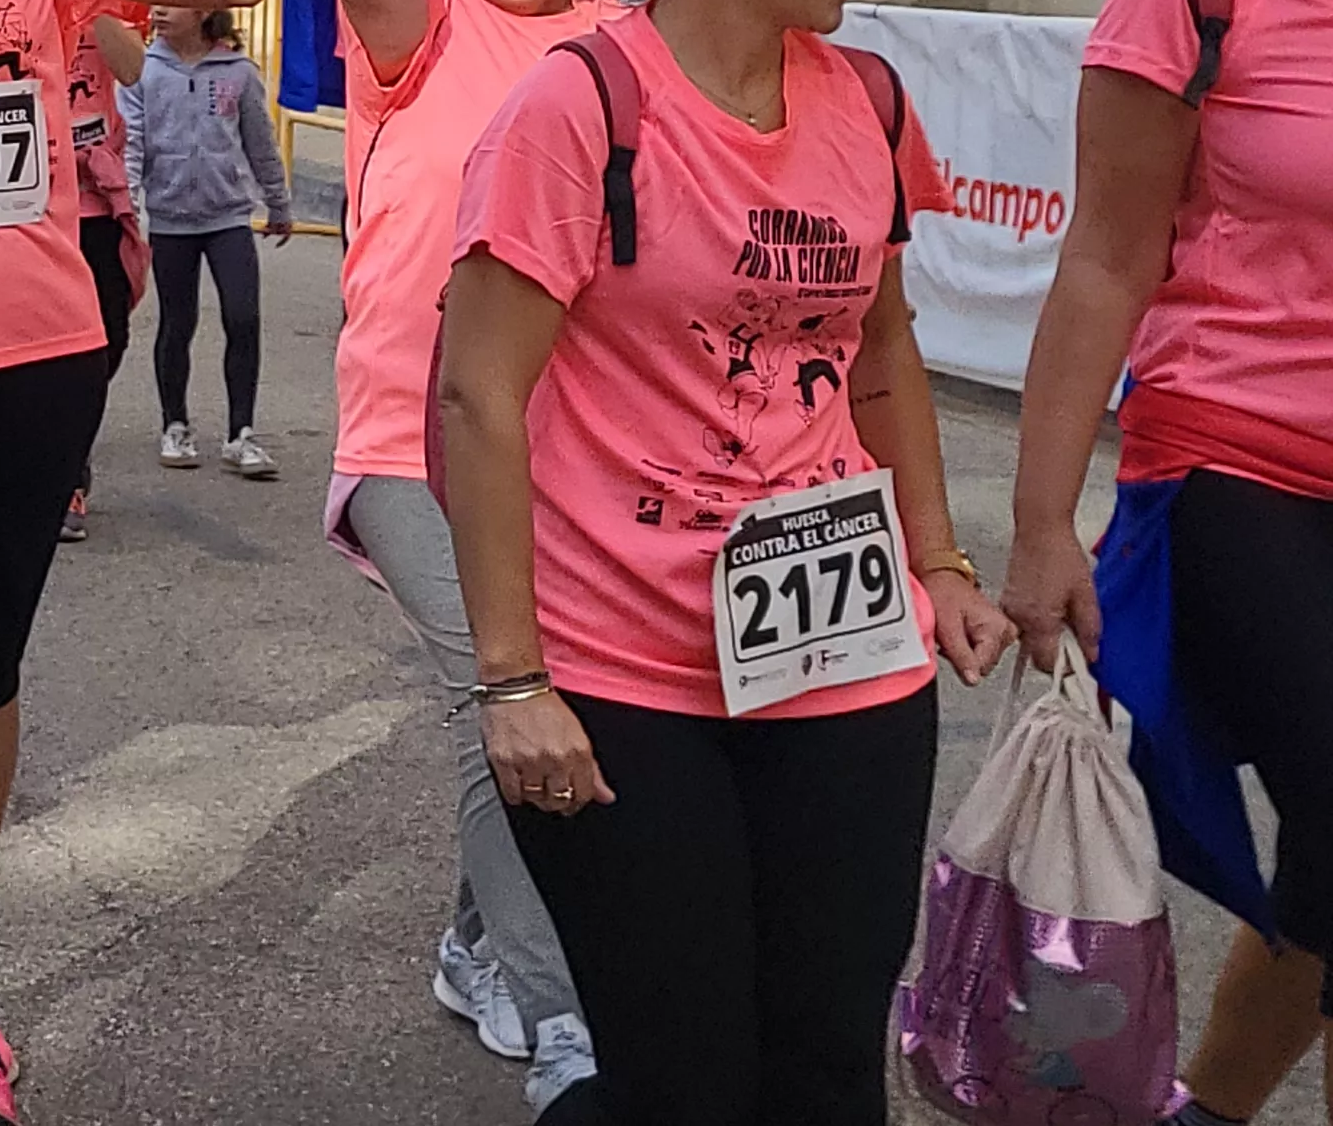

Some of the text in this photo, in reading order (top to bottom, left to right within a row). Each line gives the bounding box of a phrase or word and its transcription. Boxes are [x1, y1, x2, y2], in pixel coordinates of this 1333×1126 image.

[732, 240, 861, 284] POR LA CIENCIA
[732, 511, 881, 566] CONTRA EL CÁNCER
[782, 508, 831, 532] HUESCA
[733, 543, 893, 651] 2179
